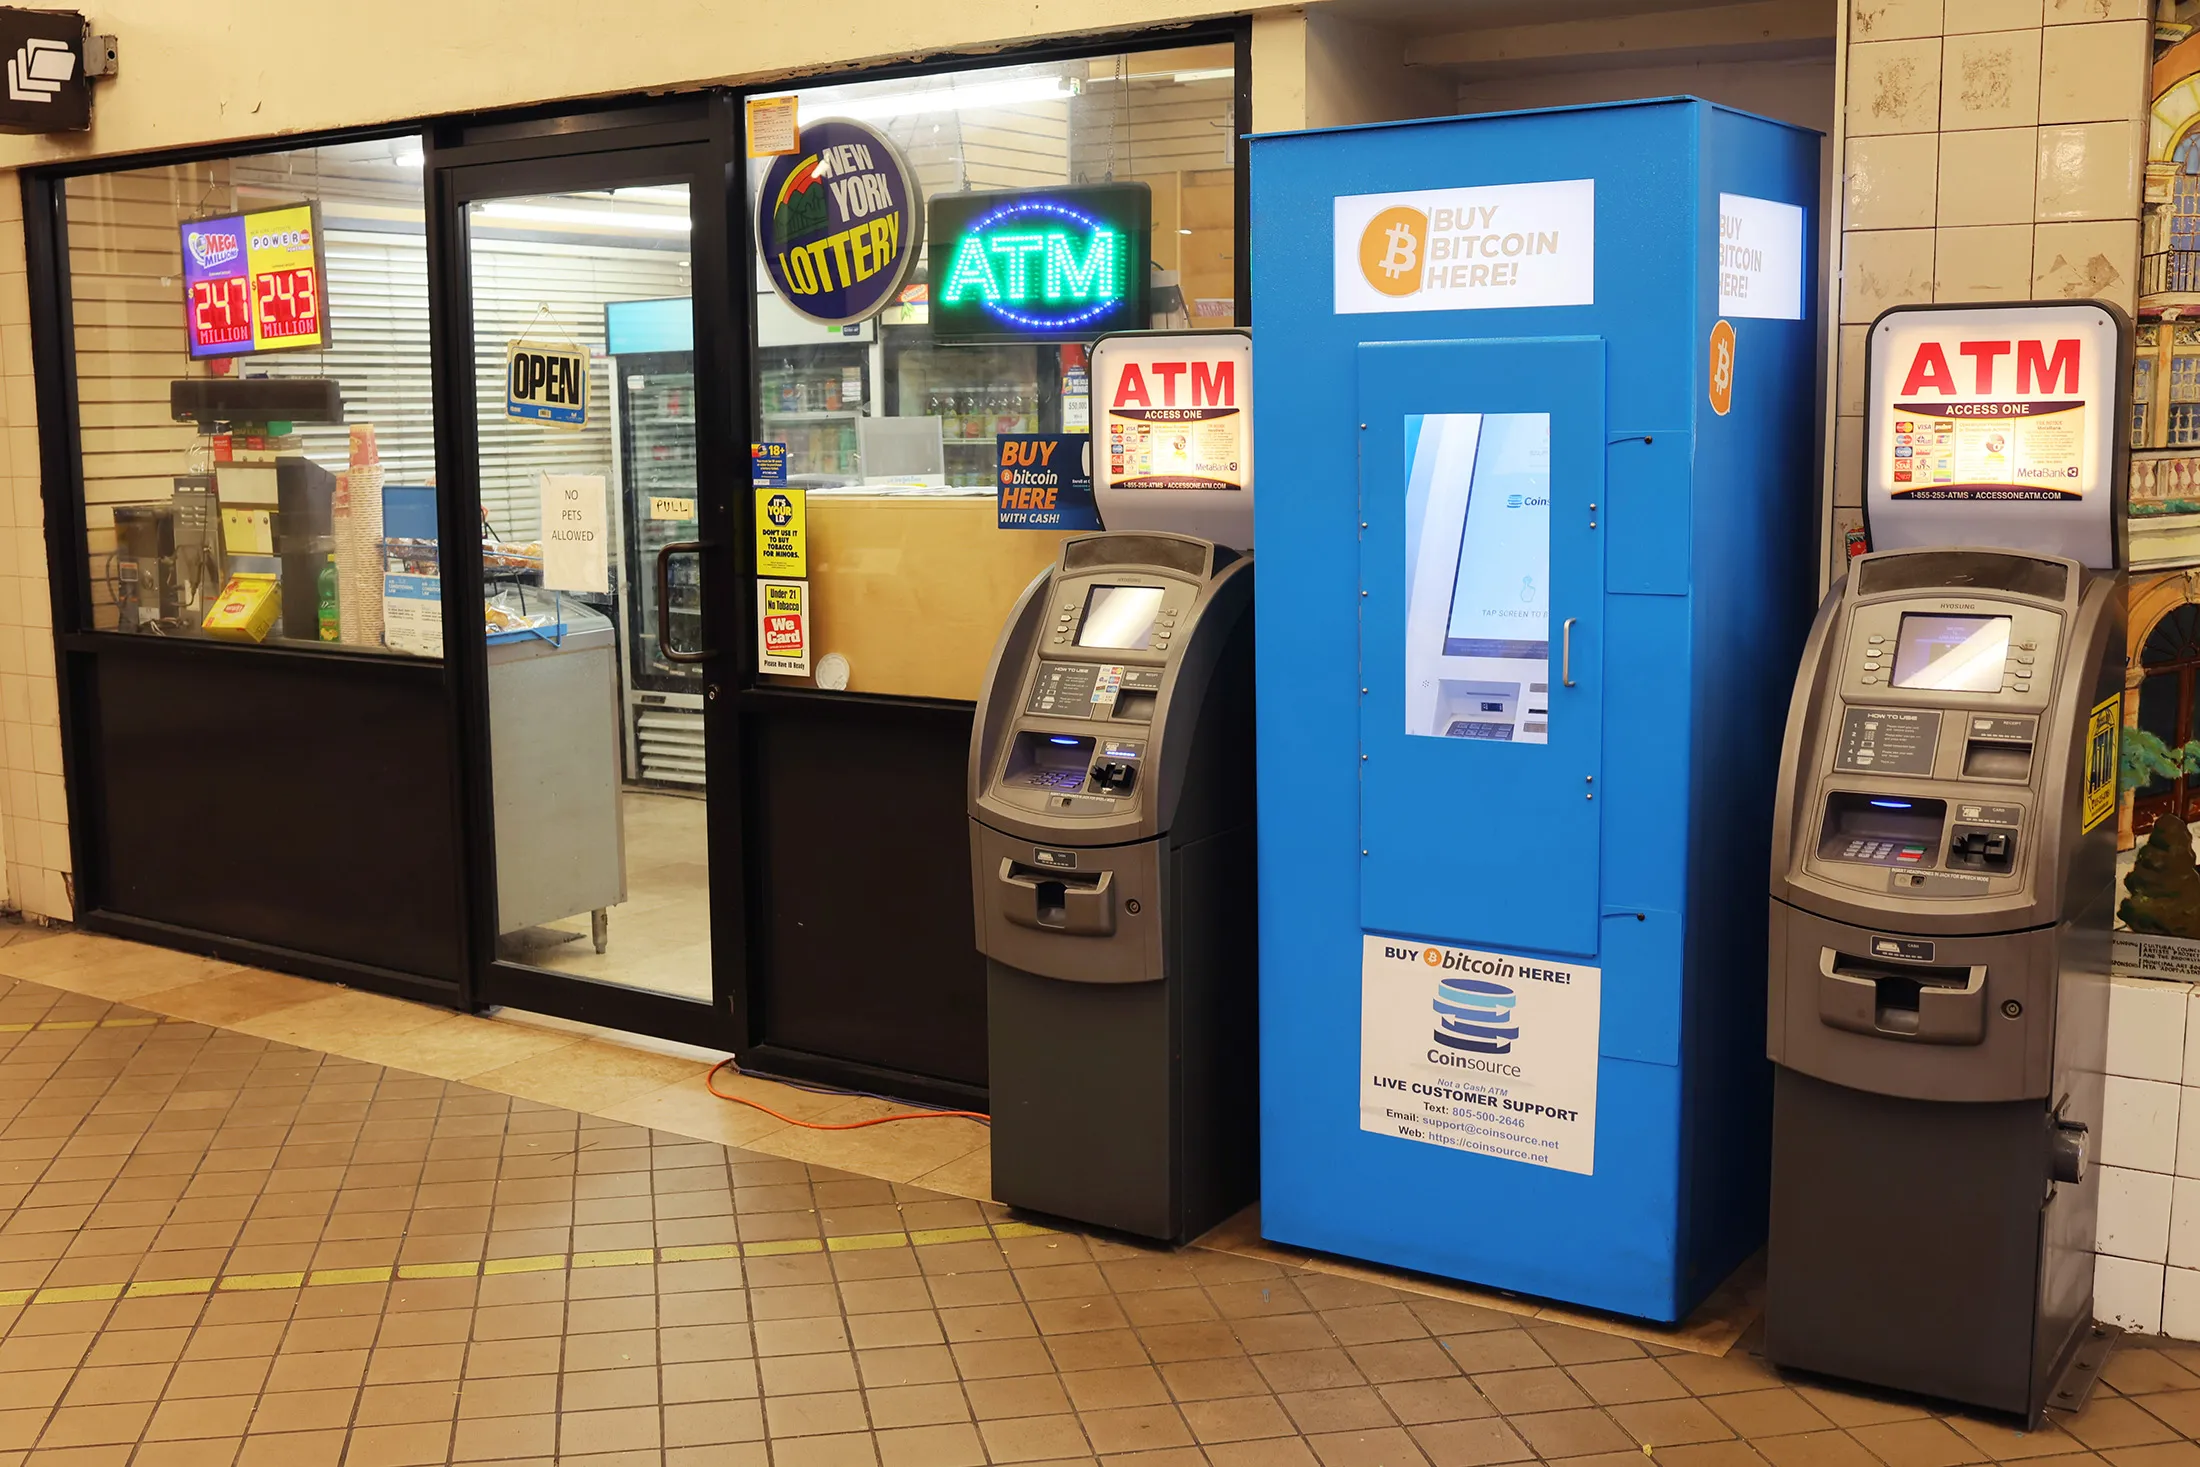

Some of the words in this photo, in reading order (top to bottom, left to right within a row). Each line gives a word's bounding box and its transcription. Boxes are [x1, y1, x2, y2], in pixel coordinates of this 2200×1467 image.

[822, 143, 875, 179] NEW
[829, 172, 893, 223] YORK
[1433, 204, 1500, 232] BUY
[204, 234, 237, 255] MEGA
[778, 210, 900, 296] LOTTERY
[1430, 230, 1560, 261] BITCOIN
[204, 249, 239, 268] MILLIONS
[944, 230, 1114, 302] ATM
[1426, 262, 1519, 290] HERE!
[200, 326, 249, 345] MILLION
[264, 319, 315, 337] MILLION
[1900, 339, 2081, 396] ATM
[513, 352, 580, 406] OPEN
[1113, 361, 1235, 407] ATM
[1144, 410, 1181, 419] ACCESS
[1182, 410, 1202, 419] ONE
[1946, 404, 1998, 415] ACCESS
[2002, 404, 2030, 415] ONE
[768, 445, 785, 456] 18+
[1001, 441, 1058, 467] BUY
[1196, 462, 1229, 472] MetaBank
[2017, 467, 2066, 478] MetaBank
[1012, 469, 1058, 485] bitcoin
[1167, 482, 1227, 490] ACCESSONEATM.COM
[564, 490, 579, 500] NO
[1001, 487, 1058, 510] HERE
[1975, 492, 2062, 500] ACCESSONEATM.COM
[562, 510, 582, 521] PETS
[656, 500, 688, 512] PULL
[768, 506, 792, 516] YOUR
[1000, 513, 1028, 524] WITH
[1029, 513, 1060, 524] CASH!
[552, 530, 594, 542] ALLOWED
[770, 588, 788, 599] Under
[789, 589, 796, 600] 21
[768, 600, 776, 610] No
[776, 600, 800, 611] Tobacco
[1498, 610, 1529, 618] SCREEN
[1531, 610, 1542, 618] TO
[770, 617, 795, 632] We
[766, 629, 801, 645] Card
[2143, 943, 2175, 951] CULTURAL
[1385, 946, 1419, 962] BUY
[1442, 950, 1514, 978] bitcoin
[1518, 966, 1571, 985] HERE!
[1427, 1048, 1521, 1078] Coinsource
[1437, 1078, 1454, 1088] Not
[1463, 1082, 1486, 1093] Cash
[1488, 1086, 1508, 1097] ATM
[1373, 1075, 1407, 1092] LIVE
[1411, 1082, 1498, 1108] CUSTOMER
[1502, 1098, 1578, 1122] SUPPORT
[1423, 1101, 1449, 1115] Text:
[1452, 1107, 1525, 1128] 805-500-2646
[1386, 1108, 1420, 1123] Email:
[1422, 1115, 1560, 1150] support@coinsource.net
[1398, 1125, 1425, 1139] Web:
[1428, 1131, 1549, 1163] https://coinsource.net
